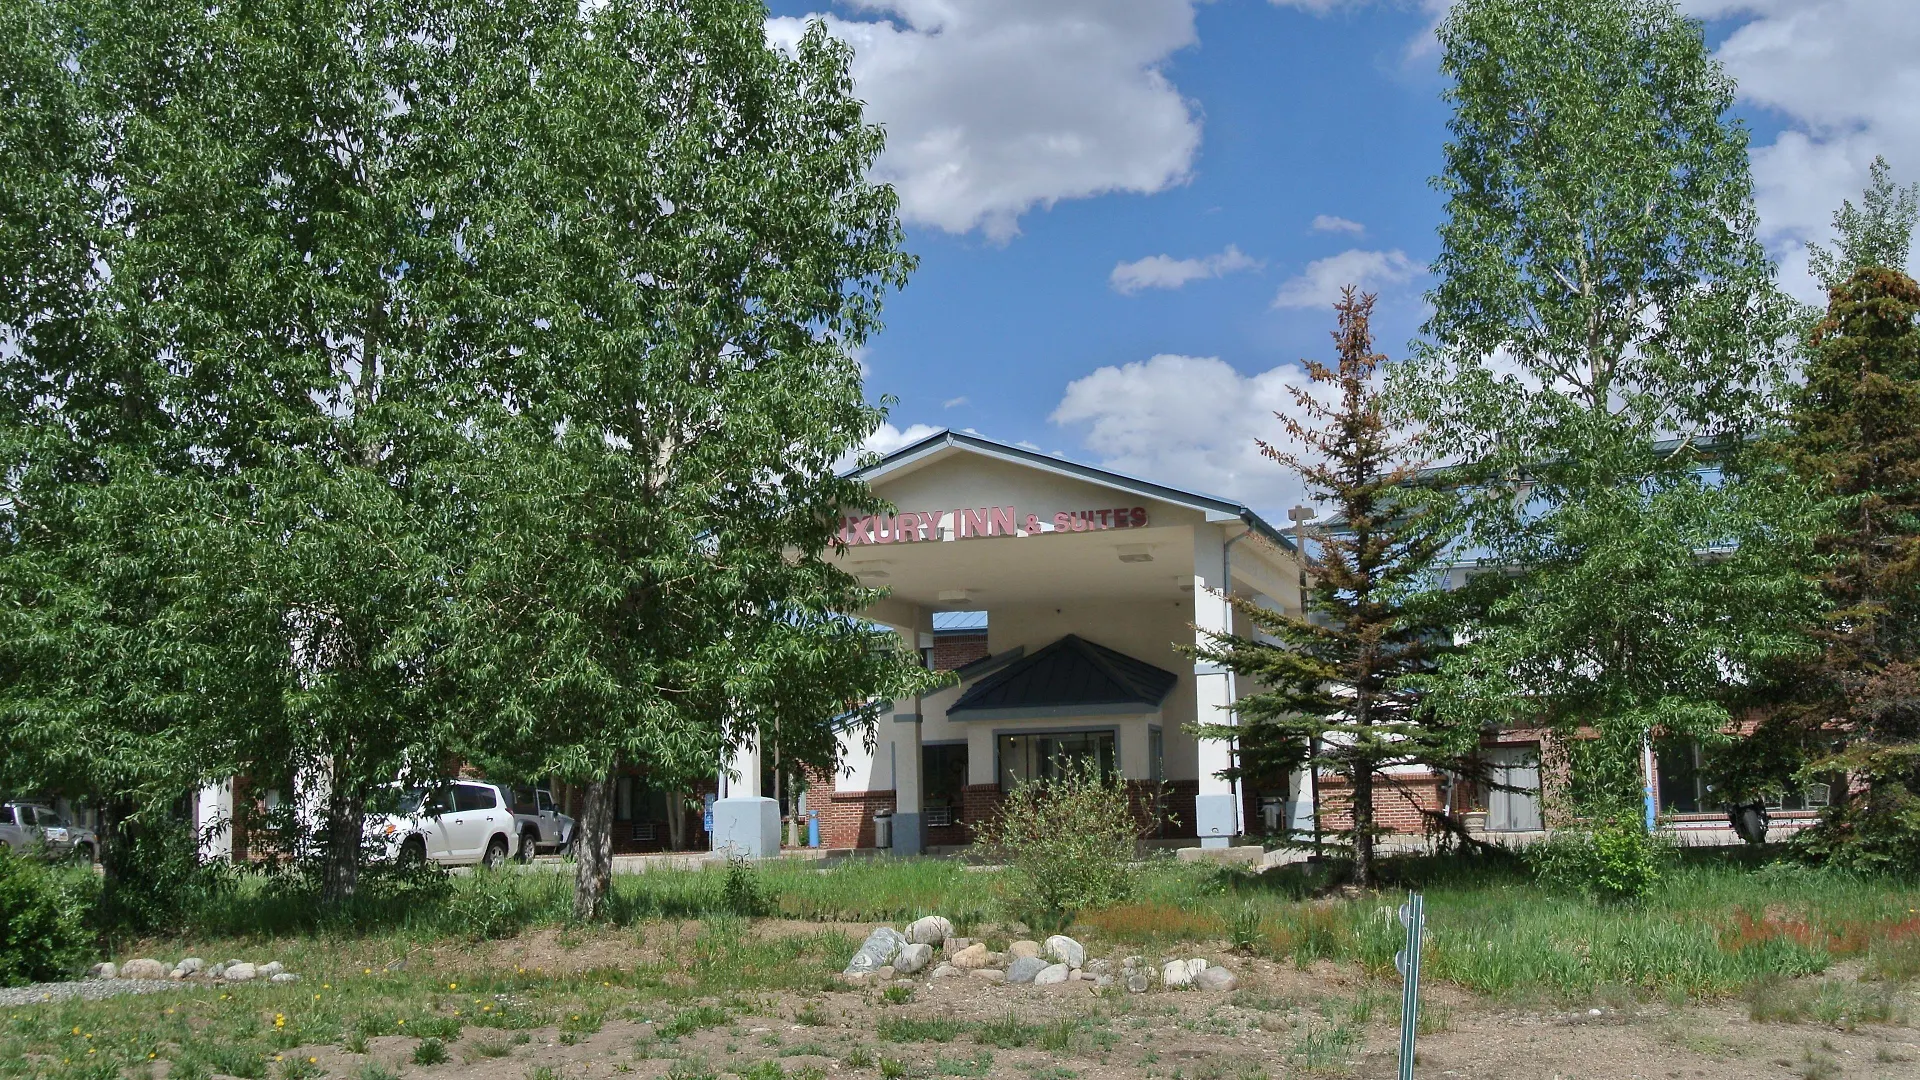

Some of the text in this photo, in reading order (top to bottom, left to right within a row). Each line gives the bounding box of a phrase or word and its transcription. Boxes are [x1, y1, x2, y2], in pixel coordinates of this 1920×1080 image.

[827, 505, 1147, 546] UXURY INN & SUITES
